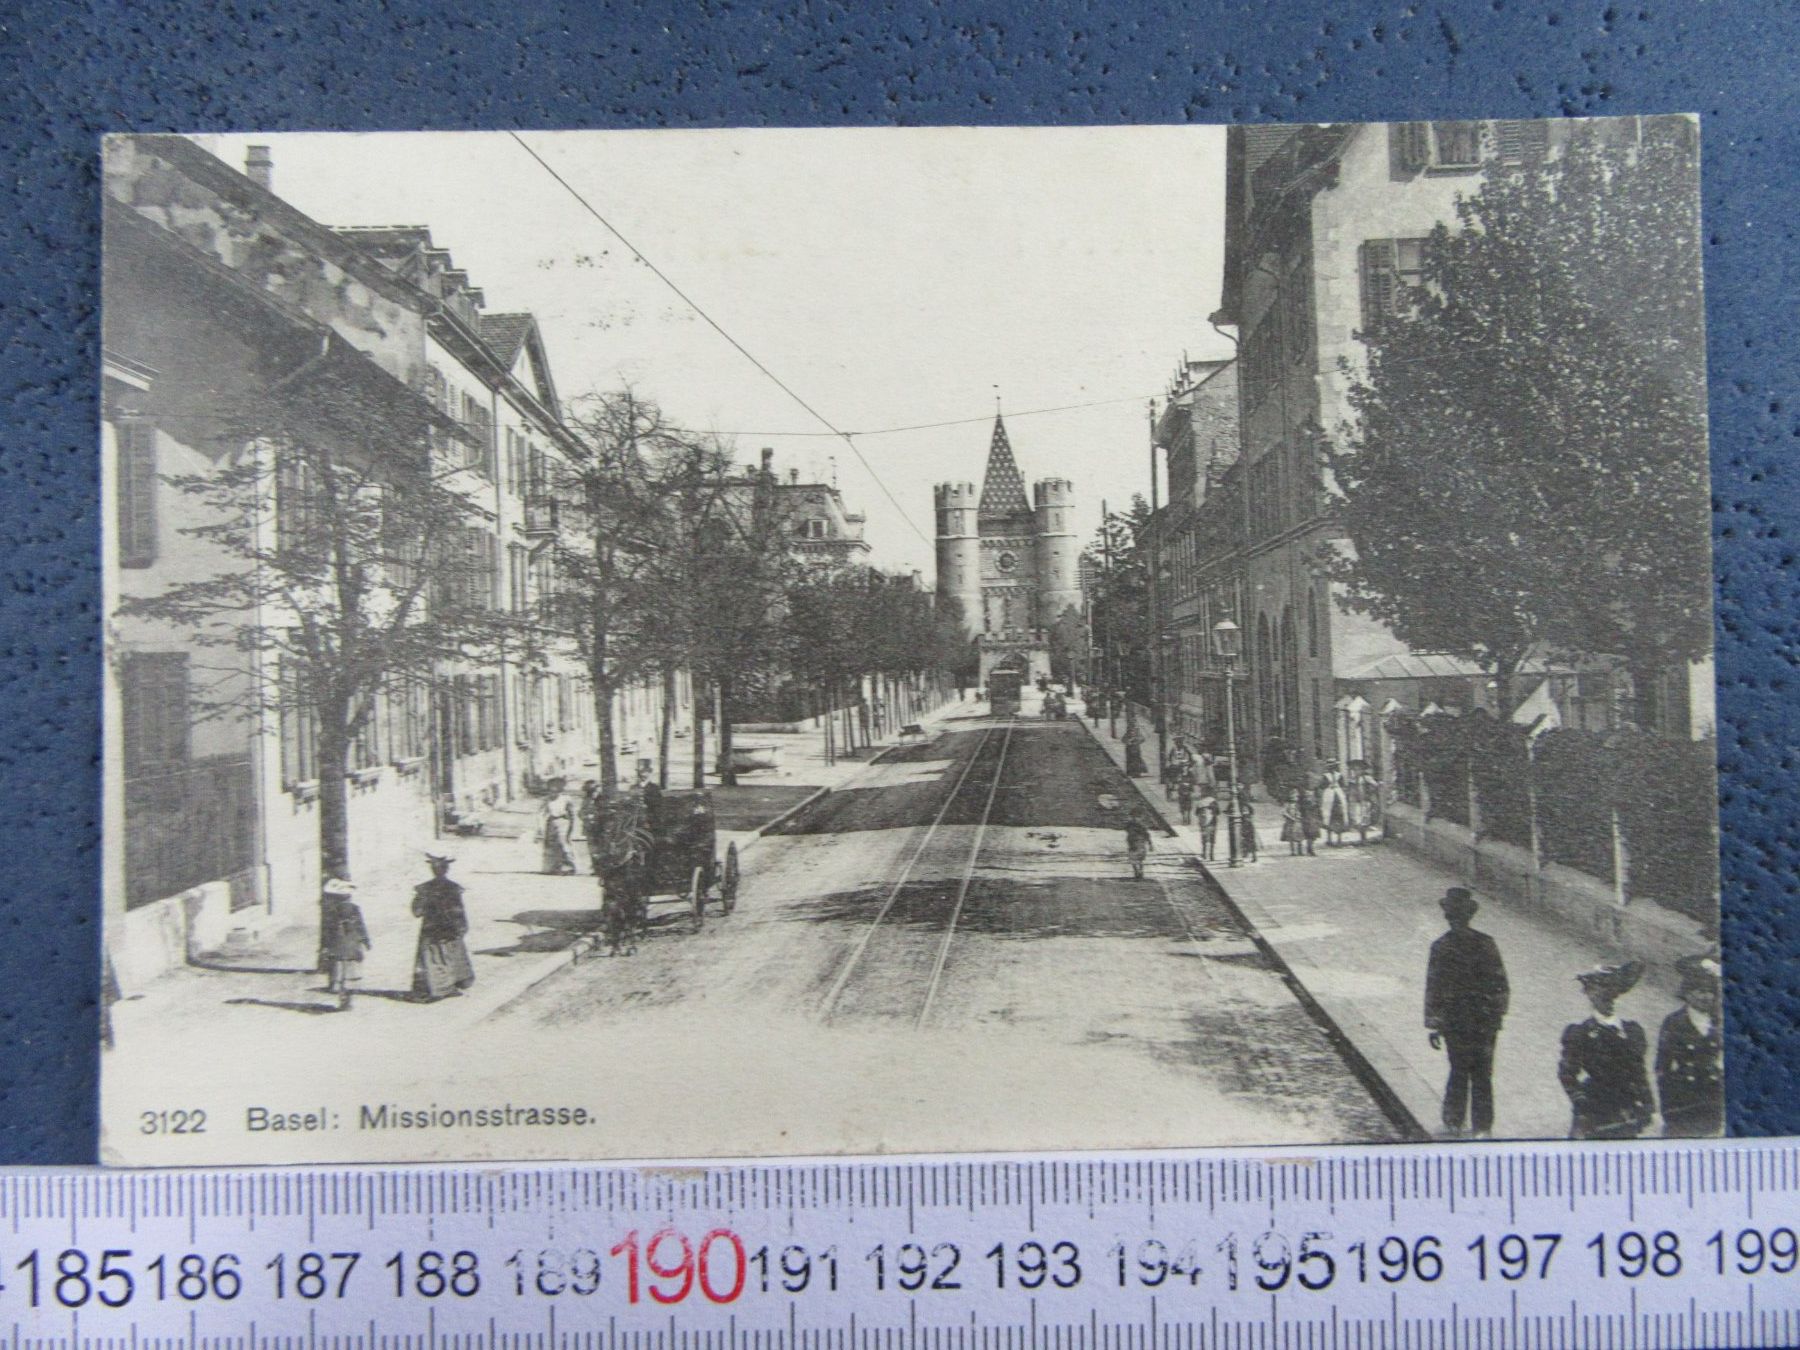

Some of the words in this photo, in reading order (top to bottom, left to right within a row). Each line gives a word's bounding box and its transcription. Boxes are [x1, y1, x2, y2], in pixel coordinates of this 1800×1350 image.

[141, 1109, 206, 1134] 3122
[247, 1107, 338, 1131] Basel:
[360, 1104, 595, 1129] Missionsstrasse.
[16, 1248, 135, 1308] 185
[147, 1253, 242, 1300] 186
[266, 1252, 361, 1299] 187
[386, 1250, 481, 1298] 188
[504, 1248, 601, 1296] 189
[610, 1229, 746, 1304] 190
[749, 1245, 838, 1292] 191
[865, 1243, 962, 1291] 192
[986, 1241, 1082, 1290] 193
[1106, 1240, 1203, 1288] 194
[1216, 1231, 1336, 1291] 195
[1347, 1235, 1444, 1283] 196
[1467, 1234, 1562, 1281] 197
[1587, 1230, 1682, 1277] 198
[1706, 1227, 1799, 1275] 199
